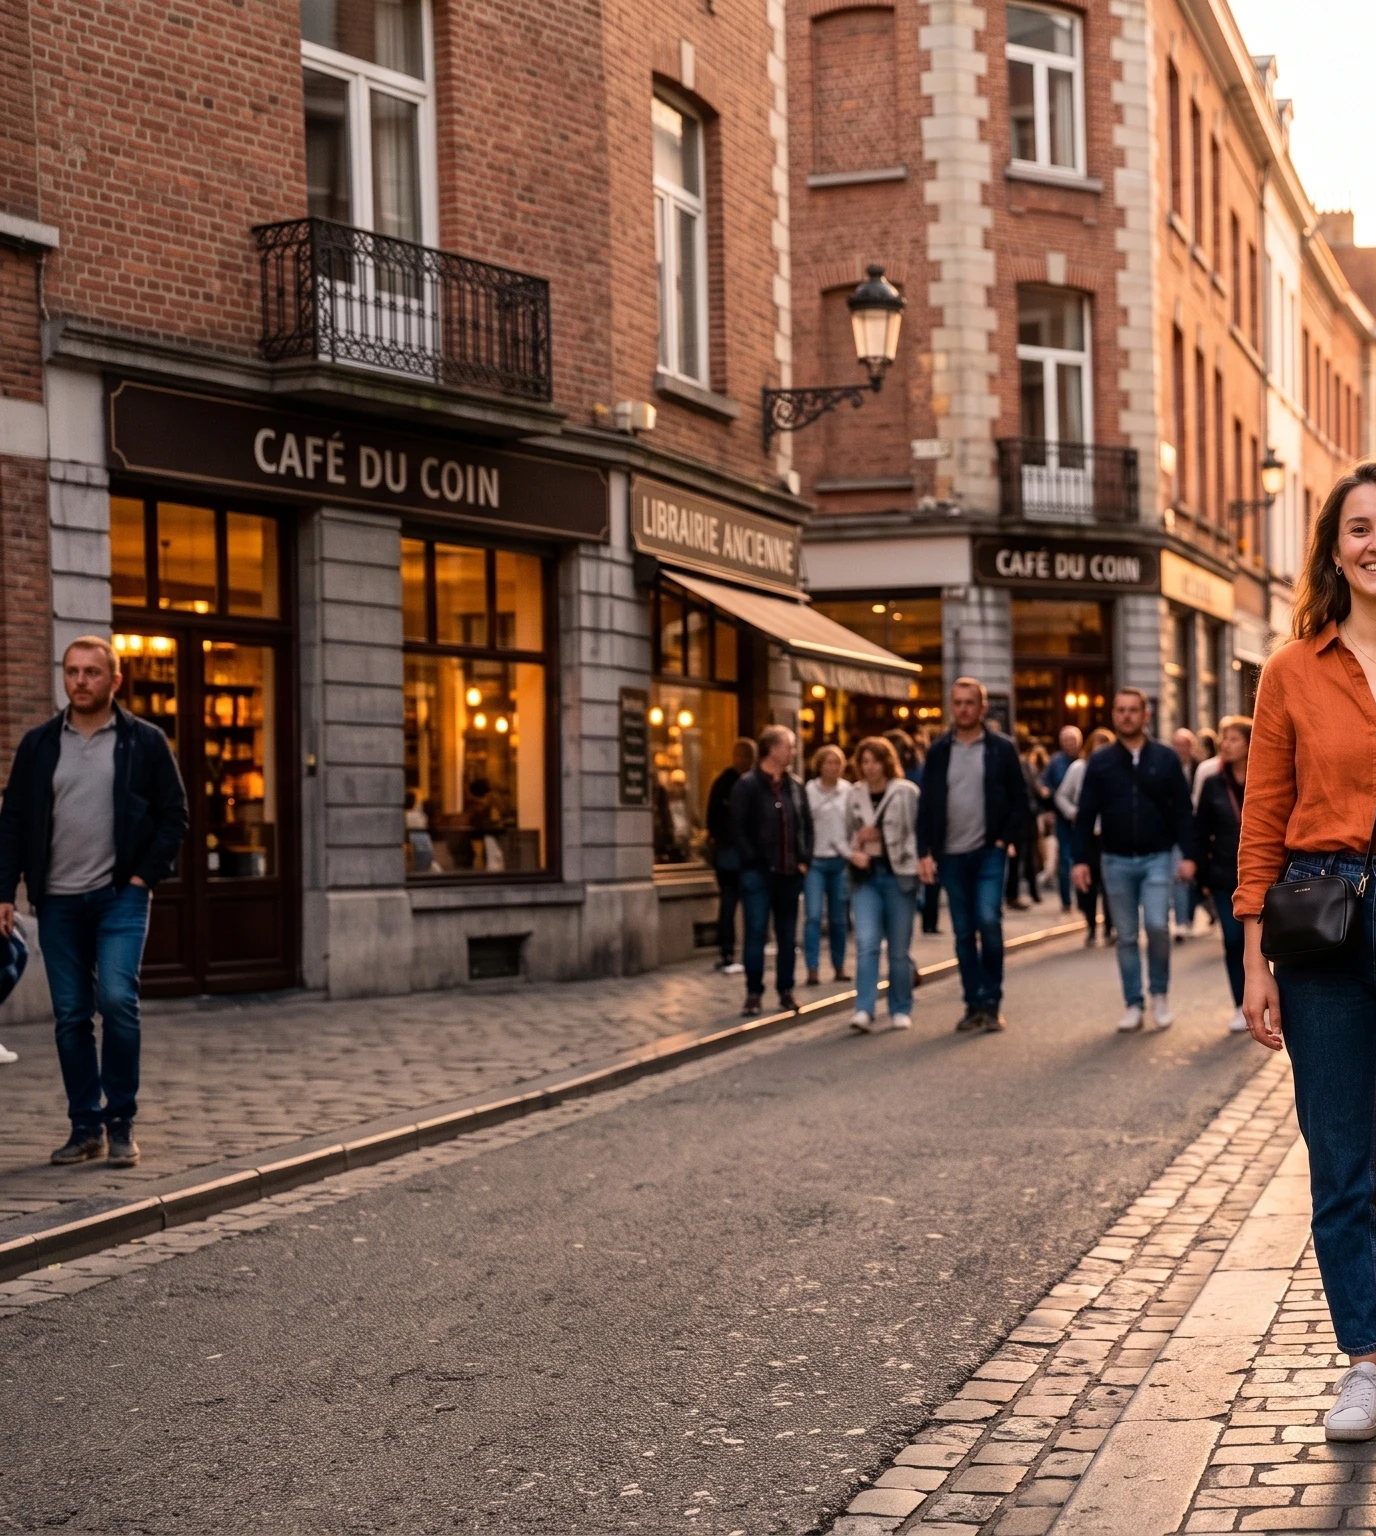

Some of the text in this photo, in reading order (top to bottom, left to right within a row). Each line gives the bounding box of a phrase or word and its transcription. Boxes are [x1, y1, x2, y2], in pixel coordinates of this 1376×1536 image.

[254, 430, 500, 508] CAFÉ DU COIN
[642, 495, 795, 576] LIBRAIRIE ANCIENNE
[995, 547, 1141, 583] CAFÉ DU COIN
